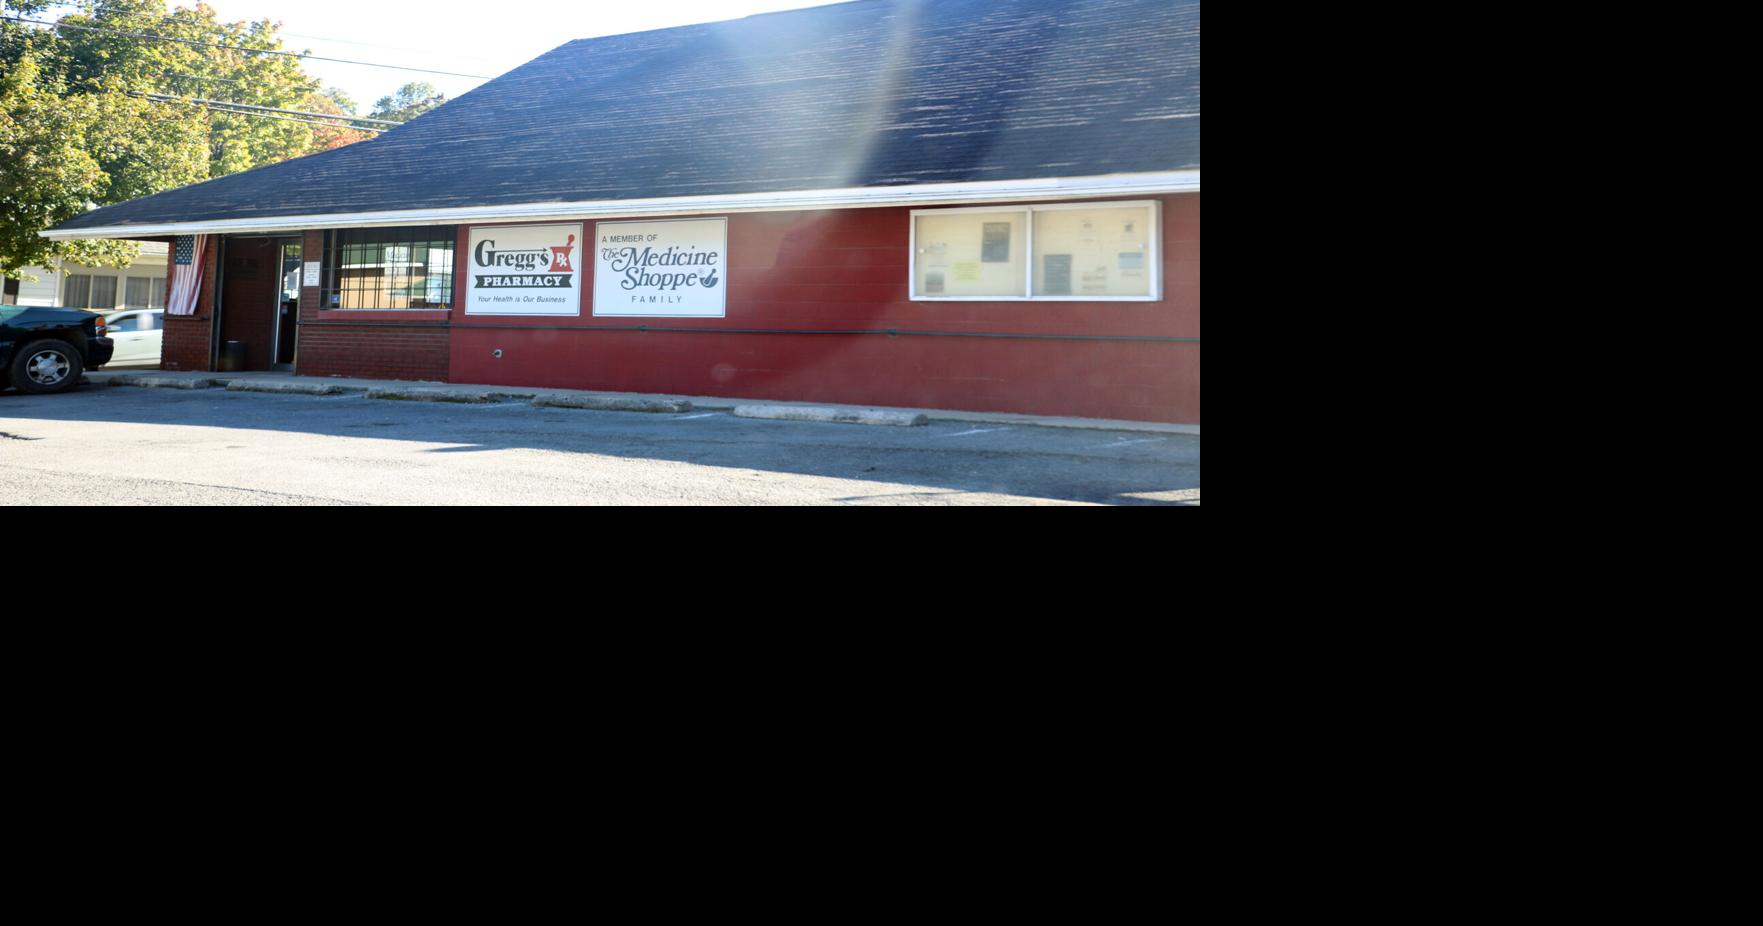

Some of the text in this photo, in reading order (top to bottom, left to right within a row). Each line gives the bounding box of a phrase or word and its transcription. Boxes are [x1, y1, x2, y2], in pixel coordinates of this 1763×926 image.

[601, 234, 658, 243] A MEMBER OF
[475, 239, 549, 271] Gregg's
[601, 245, 718, 272] The Medicine
[483, 276, 563, 287] PHARMACY
[620, 266, 698, 291] Shoppe
[478, 295, 567, 303] Your Health is Our Business
[631, 295, 682, 304] FAMILY
